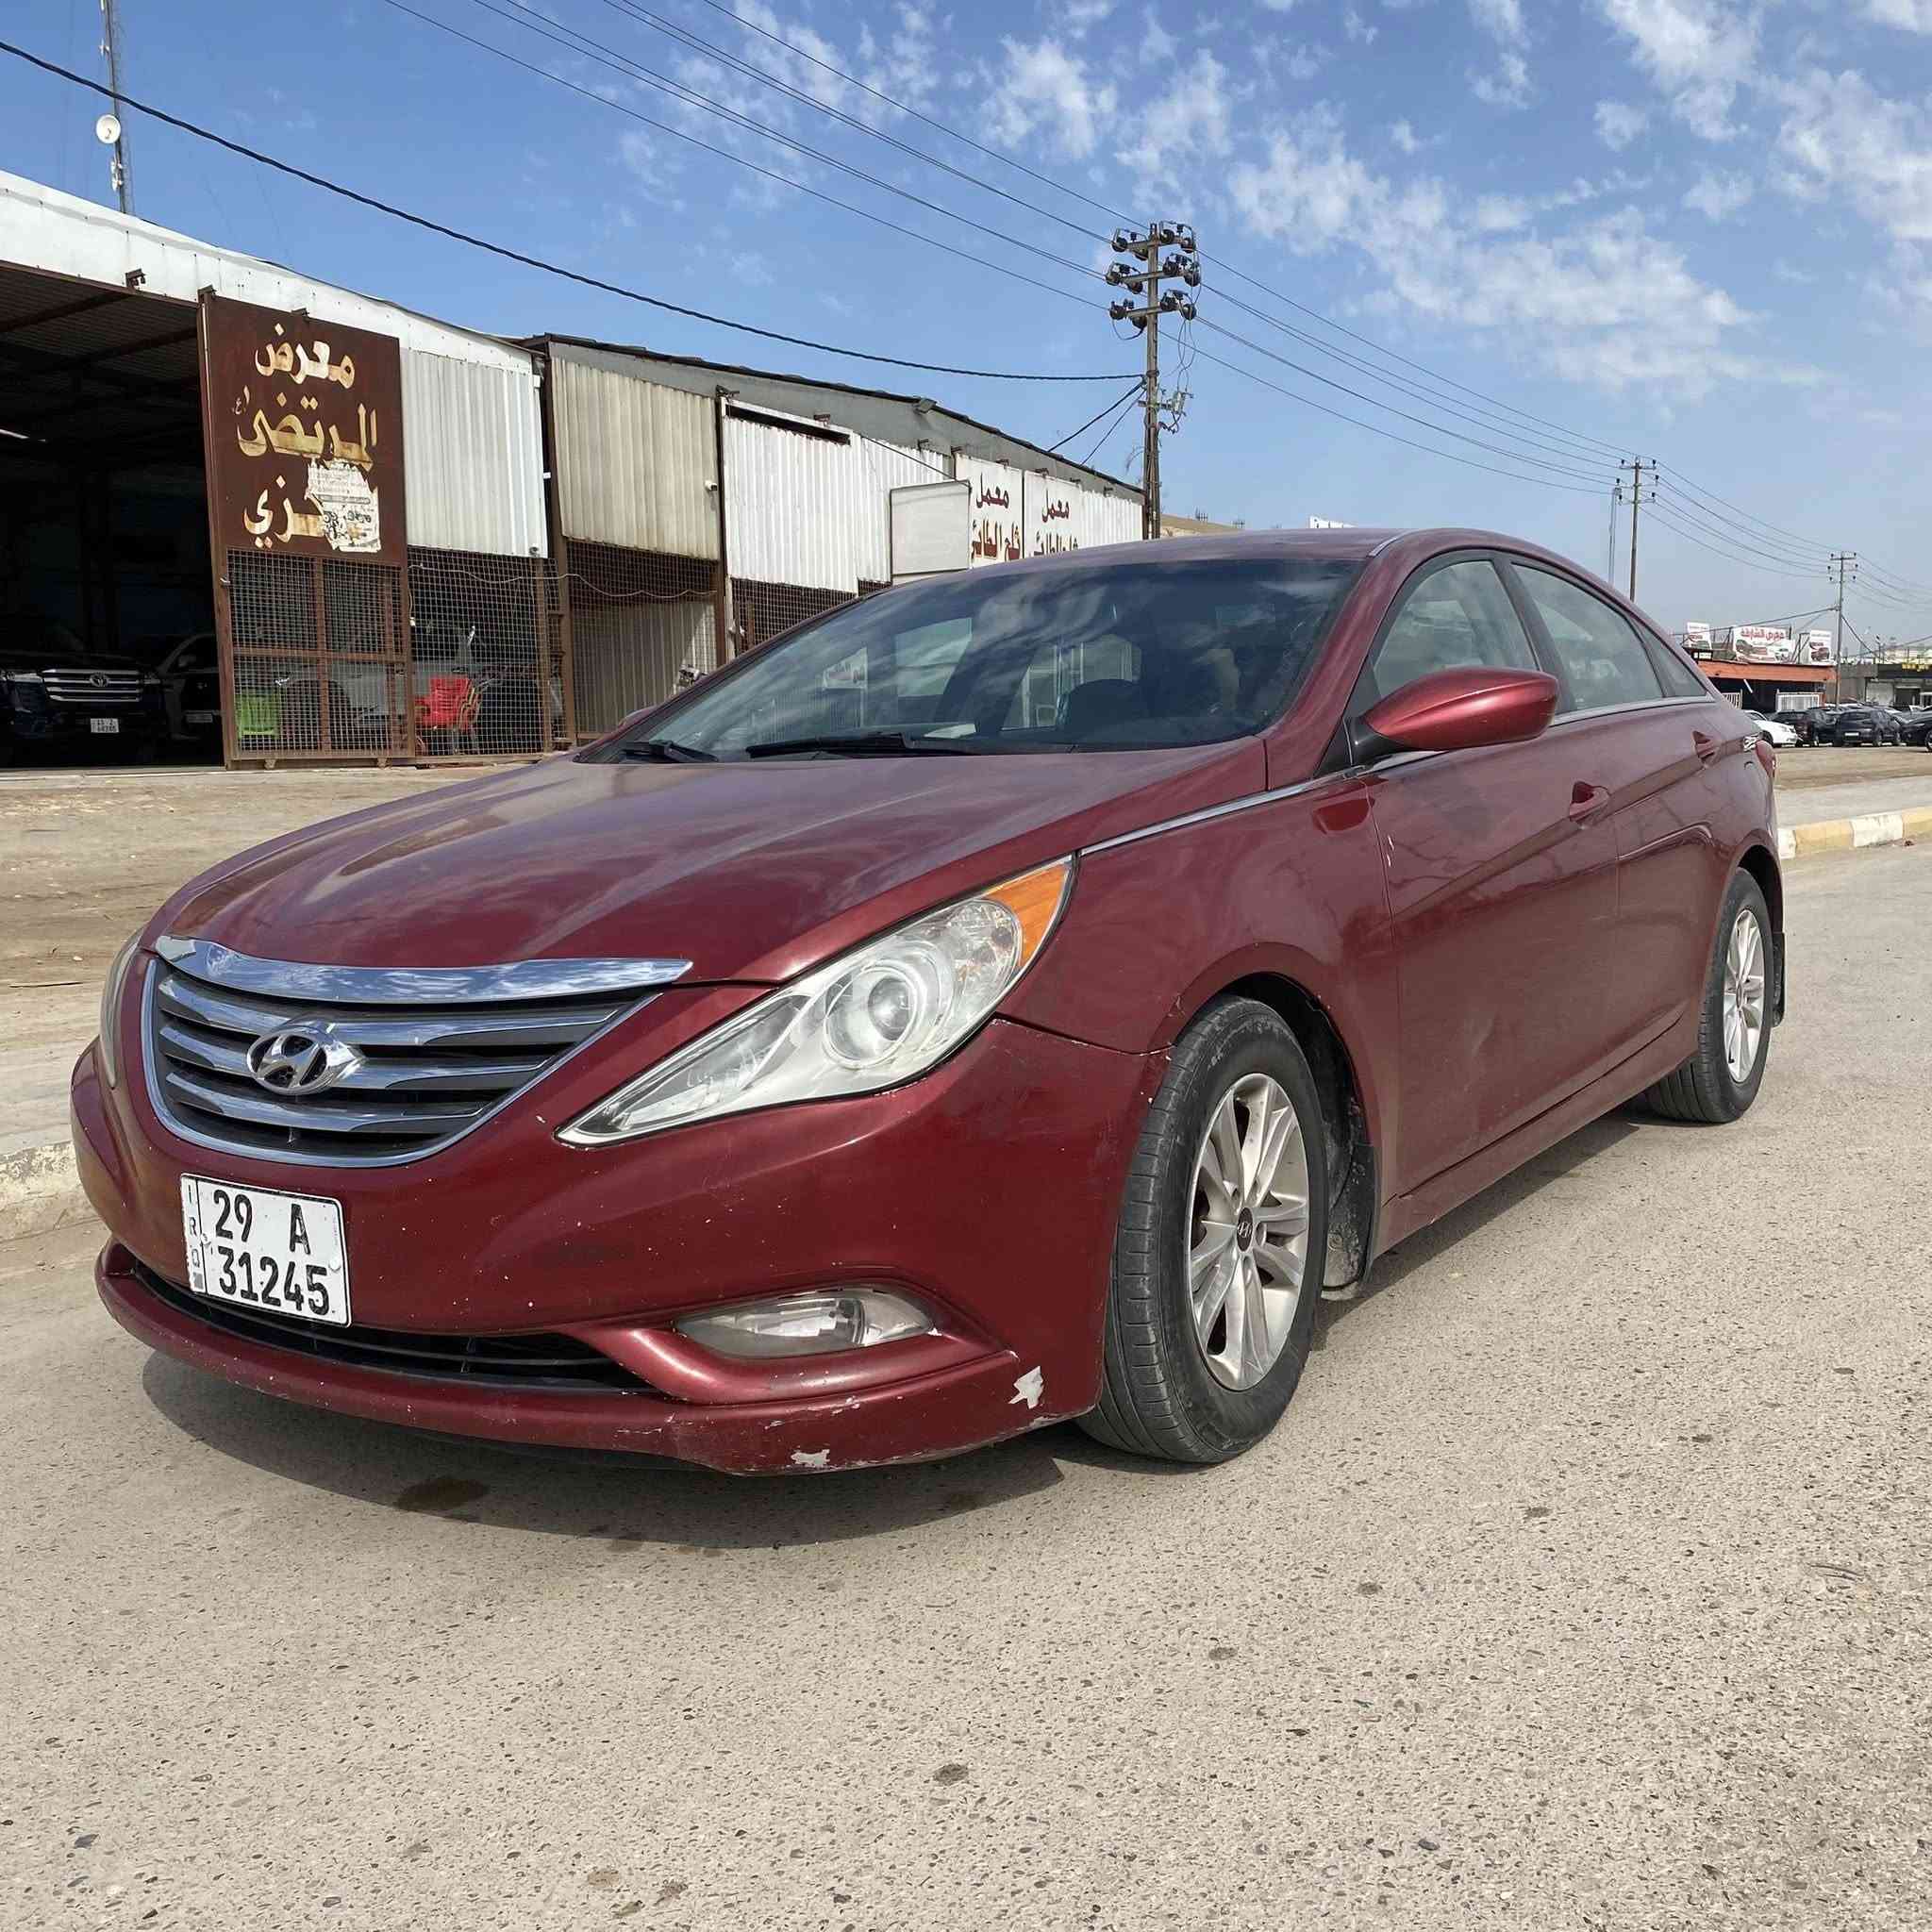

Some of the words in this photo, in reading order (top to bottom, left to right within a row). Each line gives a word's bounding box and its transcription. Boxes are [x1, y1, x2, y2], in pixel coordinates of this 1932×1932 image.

[255, 324, 355, 390] معرض
[976, 473, 1009, 508] معمل
[1041, 488, 1070, 523] معمل
[213, 1190, 253, 1241] 29
[290, 1204, 310, 1255] A
[218, 1245, 329, 1315] 31245
